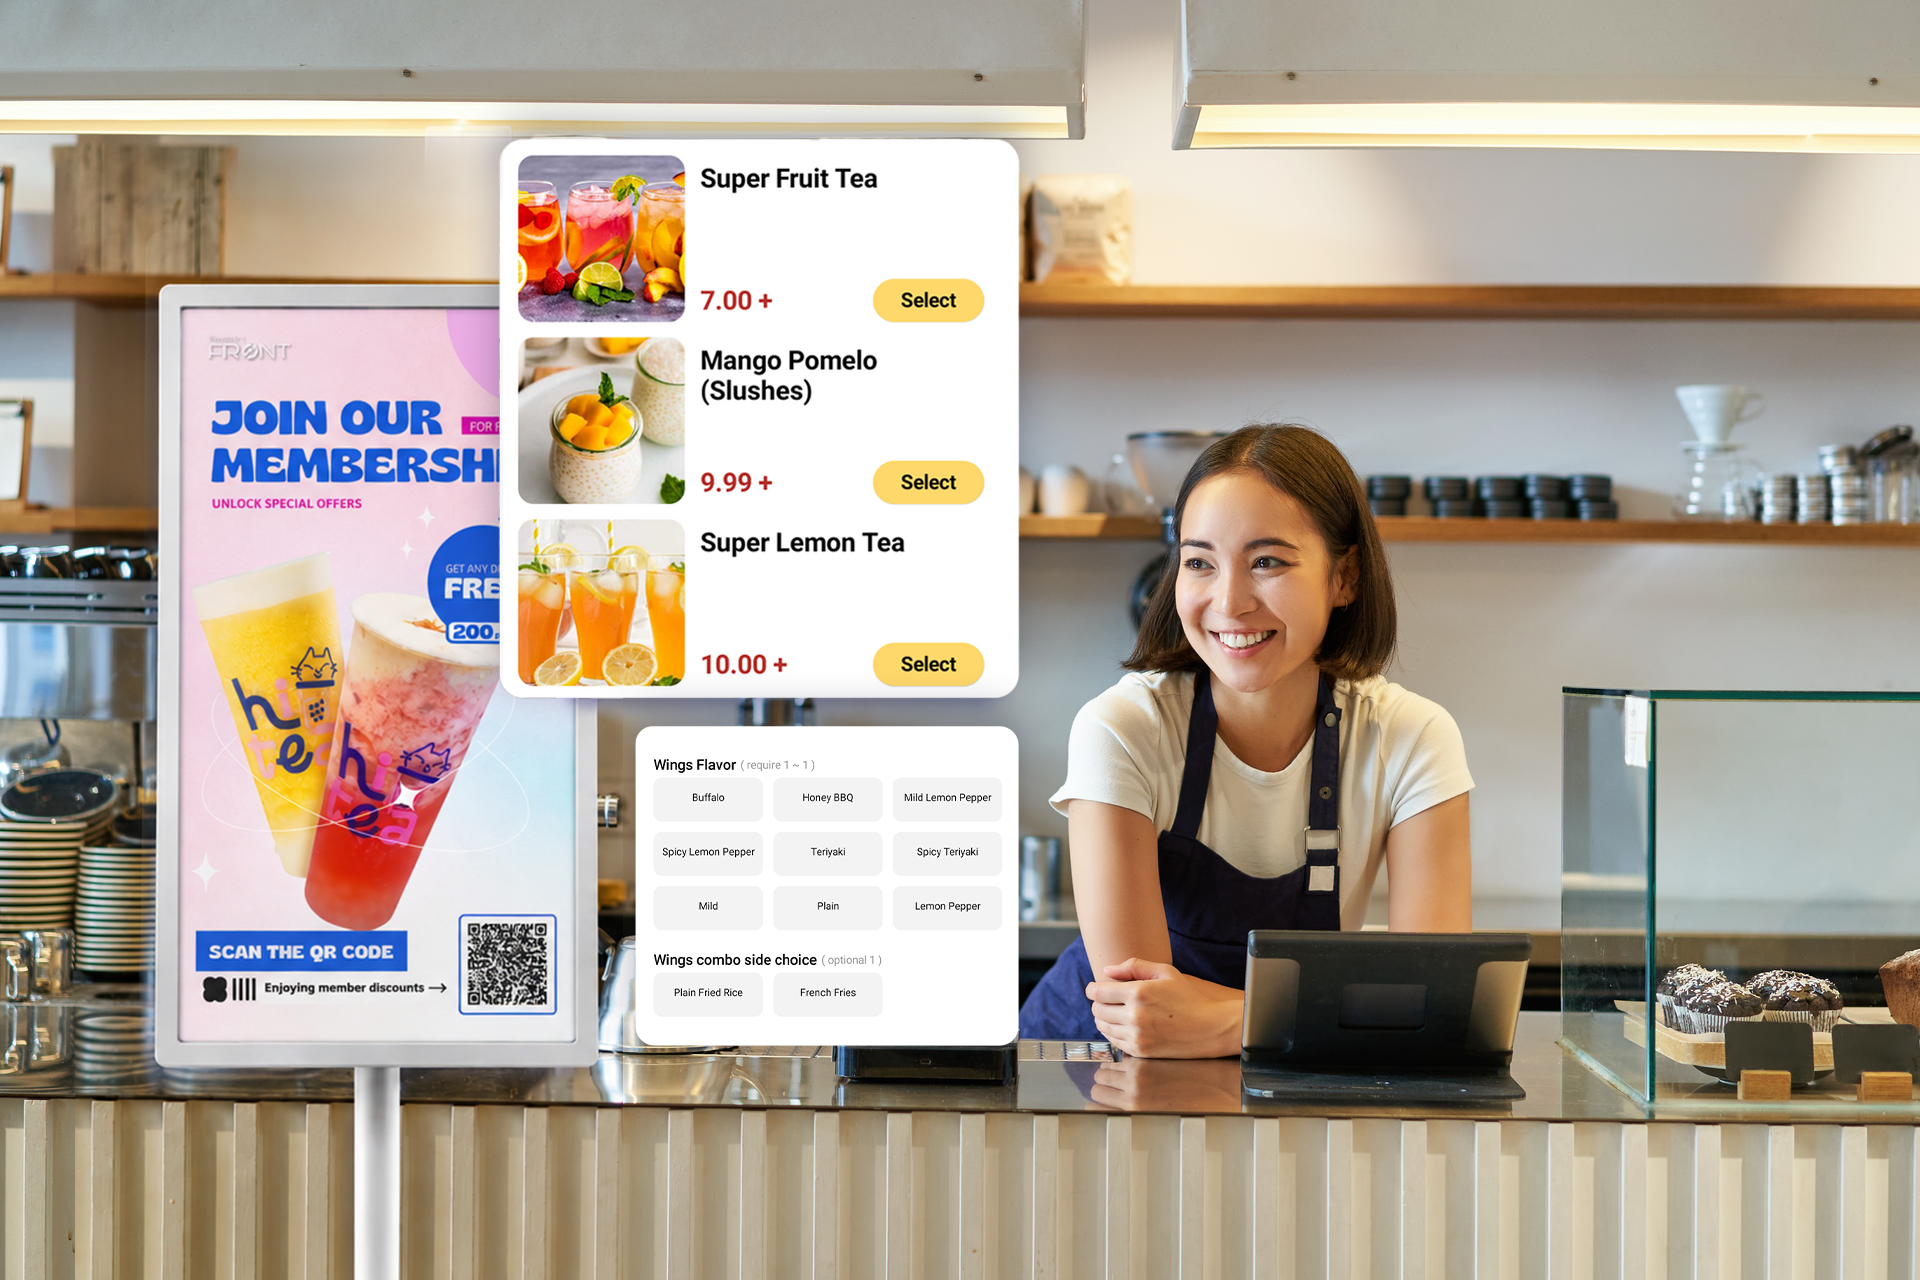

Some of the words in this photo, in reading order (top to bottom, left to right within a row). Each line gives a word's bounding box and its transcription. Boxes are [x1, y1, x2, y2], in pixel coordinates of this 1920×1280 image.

[211, 400, 328, 436] JOIN
[340, 400, 443, 436] OUR
[469, 421, 493, 433] FOR
[212, 498, 262, 509] UNLOCK
[264, 498, 314, 509] SPECIAL
[316, 498, 363, 509] OFFERS
[445, 563, 465, 574] GET
[467, 564, 489, 574] ANY
[452, 624, 494, 640] 200
[208, 944, 262, 960] SCAN
[266, 944, 305, 960] THE
[309, 944, 337, 962] QR
[341, 944, 395, 960] CODE
[264, 982, 316, 996] Enjoying
[318, 982, 367, 993] member
[368, 982, 425, 993] discounts
